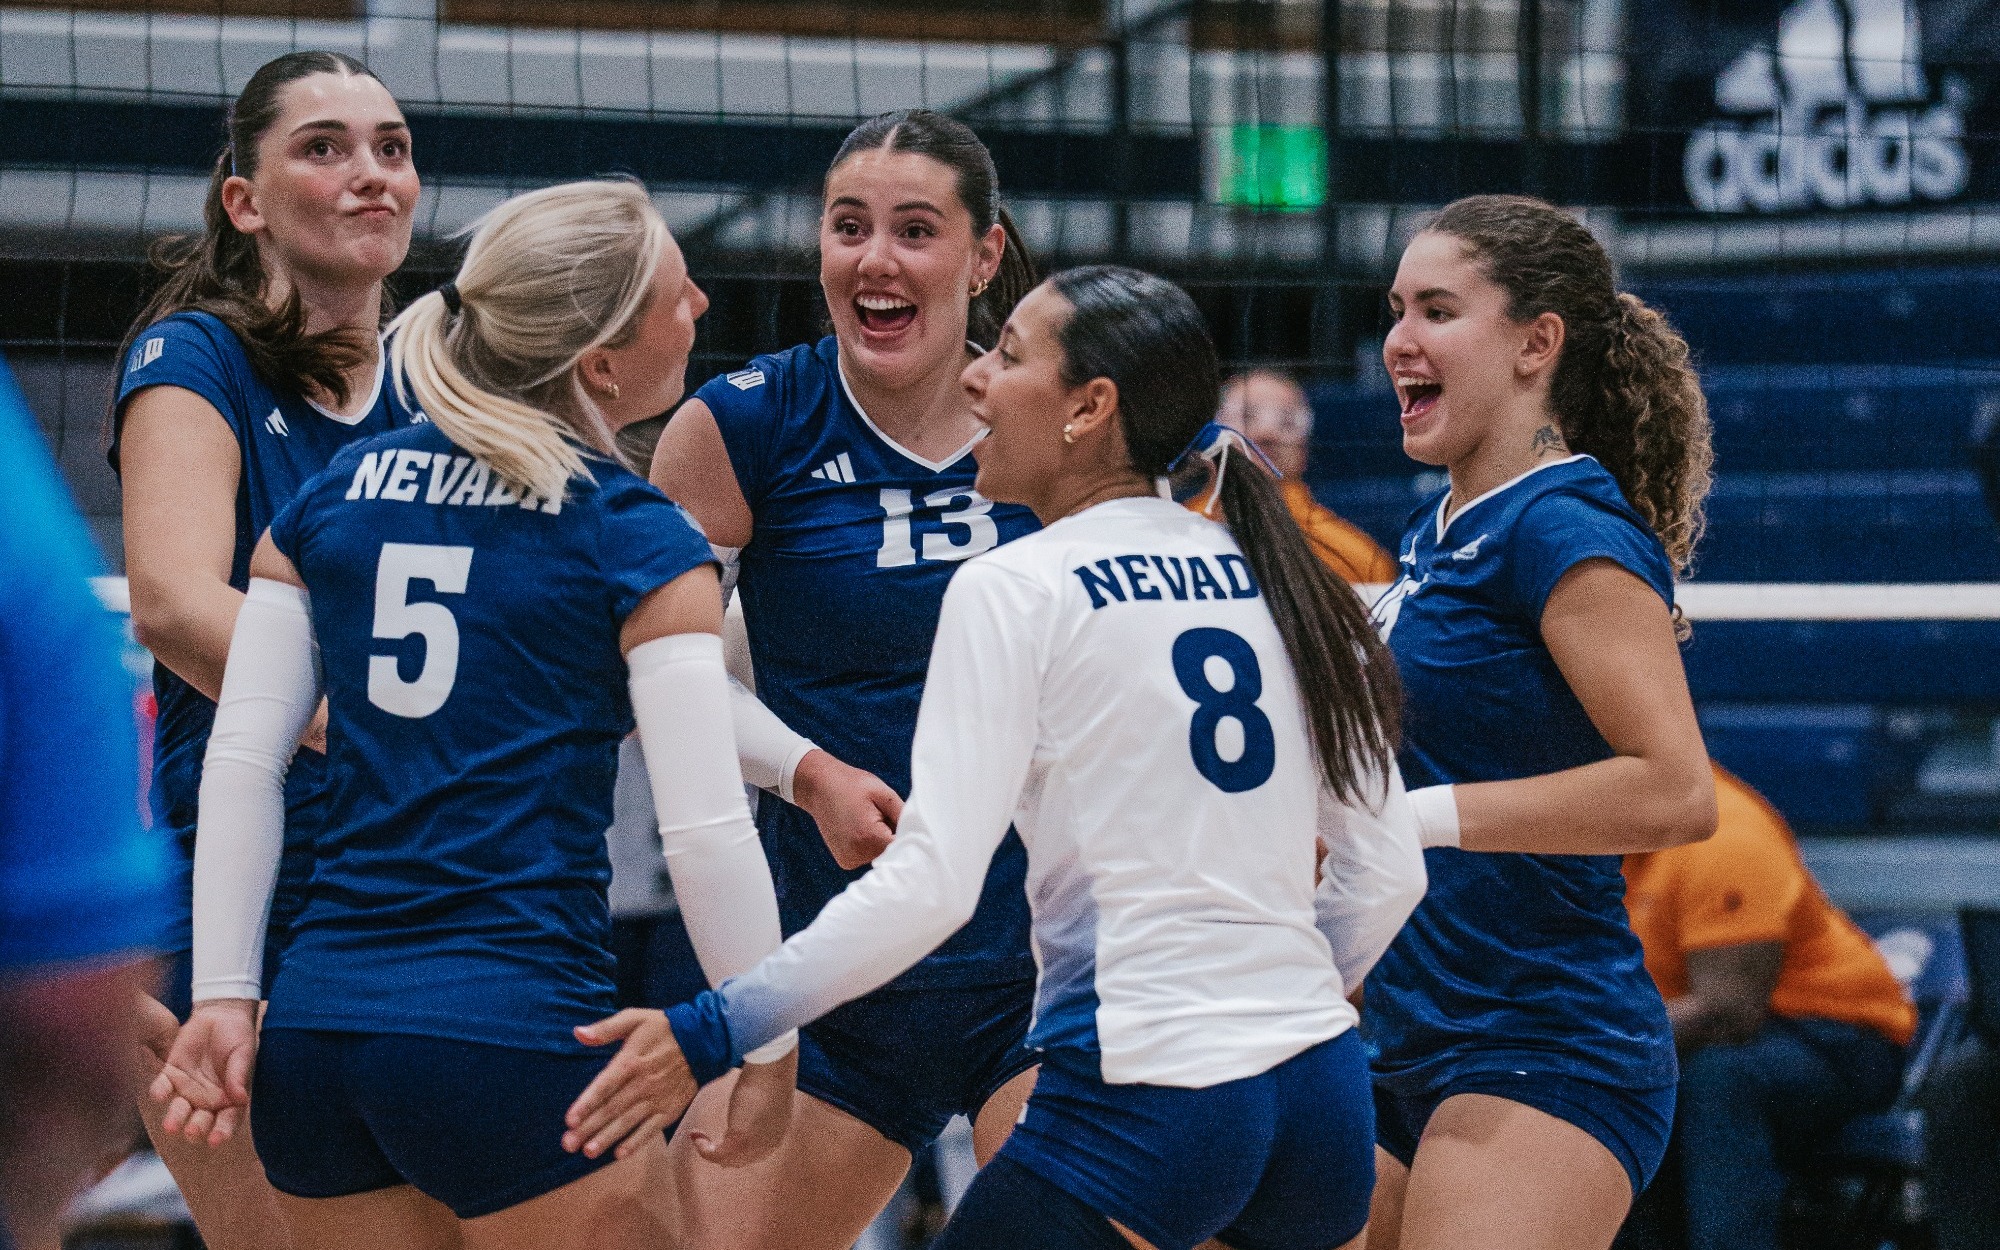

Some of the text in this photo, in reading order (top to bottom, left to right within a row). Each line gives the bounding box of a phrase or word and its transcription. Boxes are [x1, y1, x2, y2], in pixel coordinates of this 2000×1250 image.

[1683, 99, 1969, 212] adidas
[876, 485, 998, 568] 13
[367, 542, 475, 719] 5
[1171, 626, 1276, 794] 8
